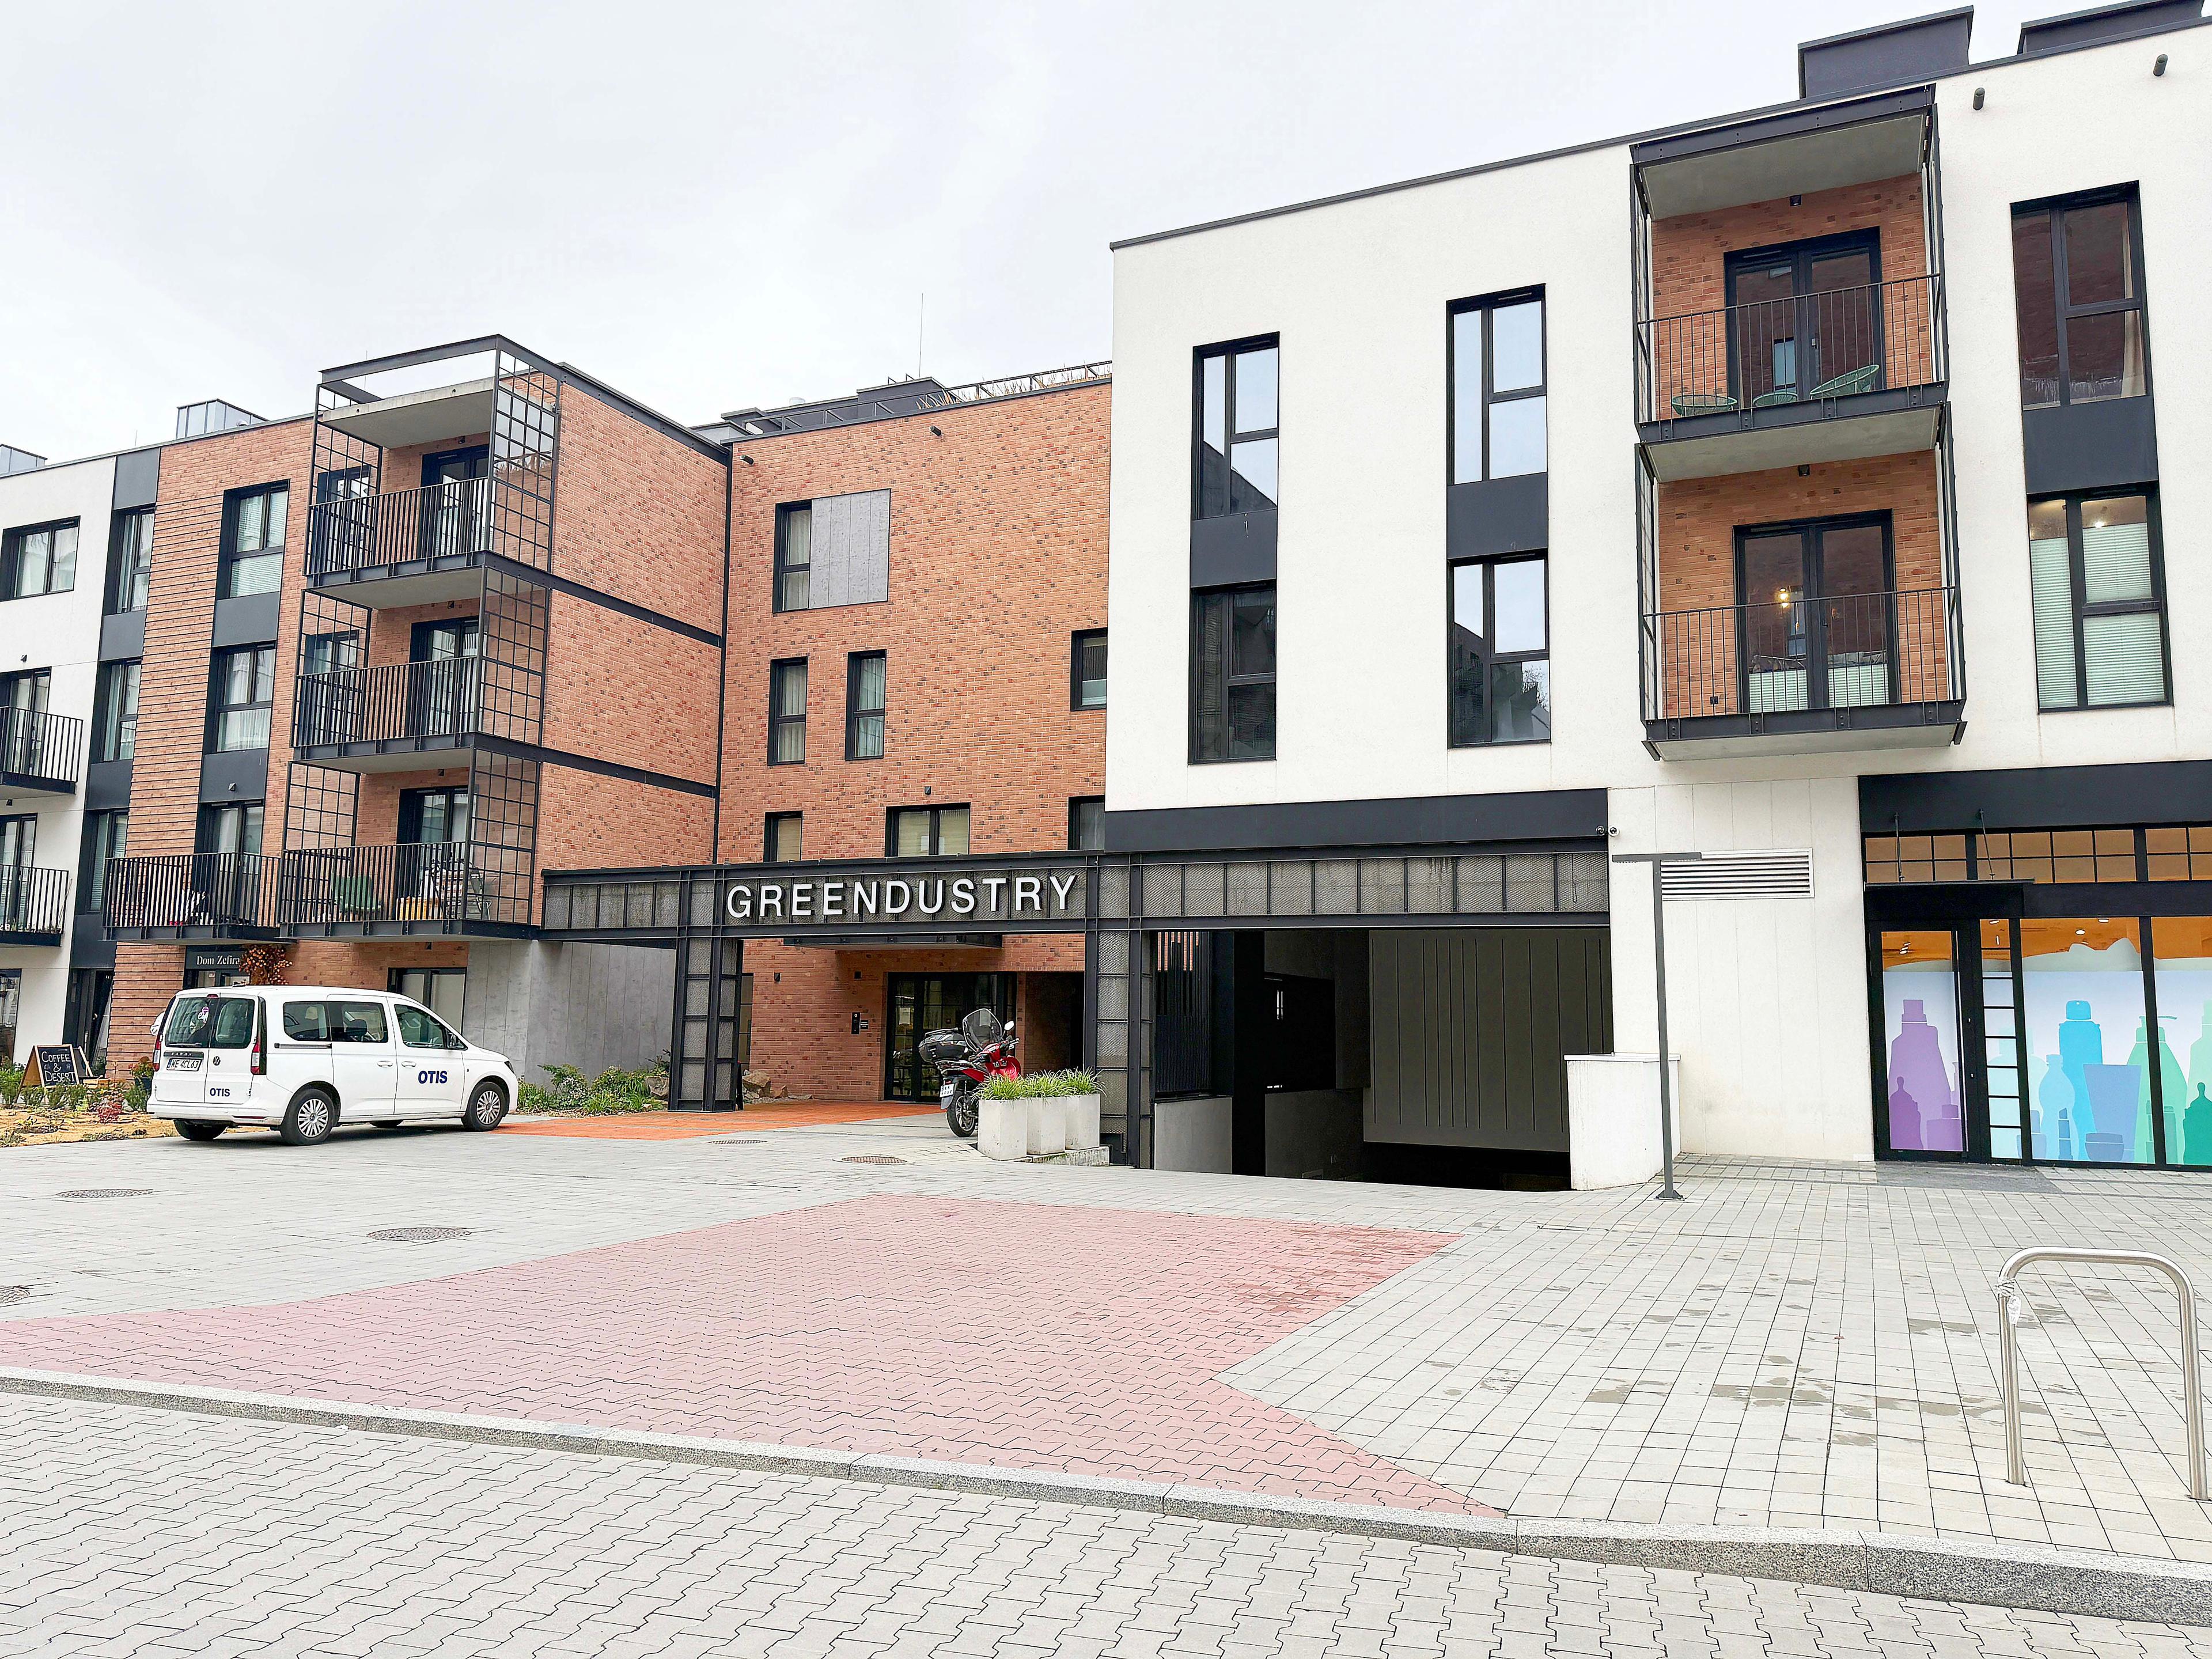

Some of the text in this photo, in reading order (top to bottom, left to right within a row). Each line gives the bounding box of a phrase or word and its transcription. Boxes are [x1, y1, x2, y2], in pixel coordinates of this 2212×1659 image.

[726, 874, 1078, 918] GREENDUSTRY
[196, 955, 214, 965] Dom
[54, 1063, 62, 1072] &
[418, 1070, 448, 1084] OTIS
[210, 1088, 230, 1097] OTIS
